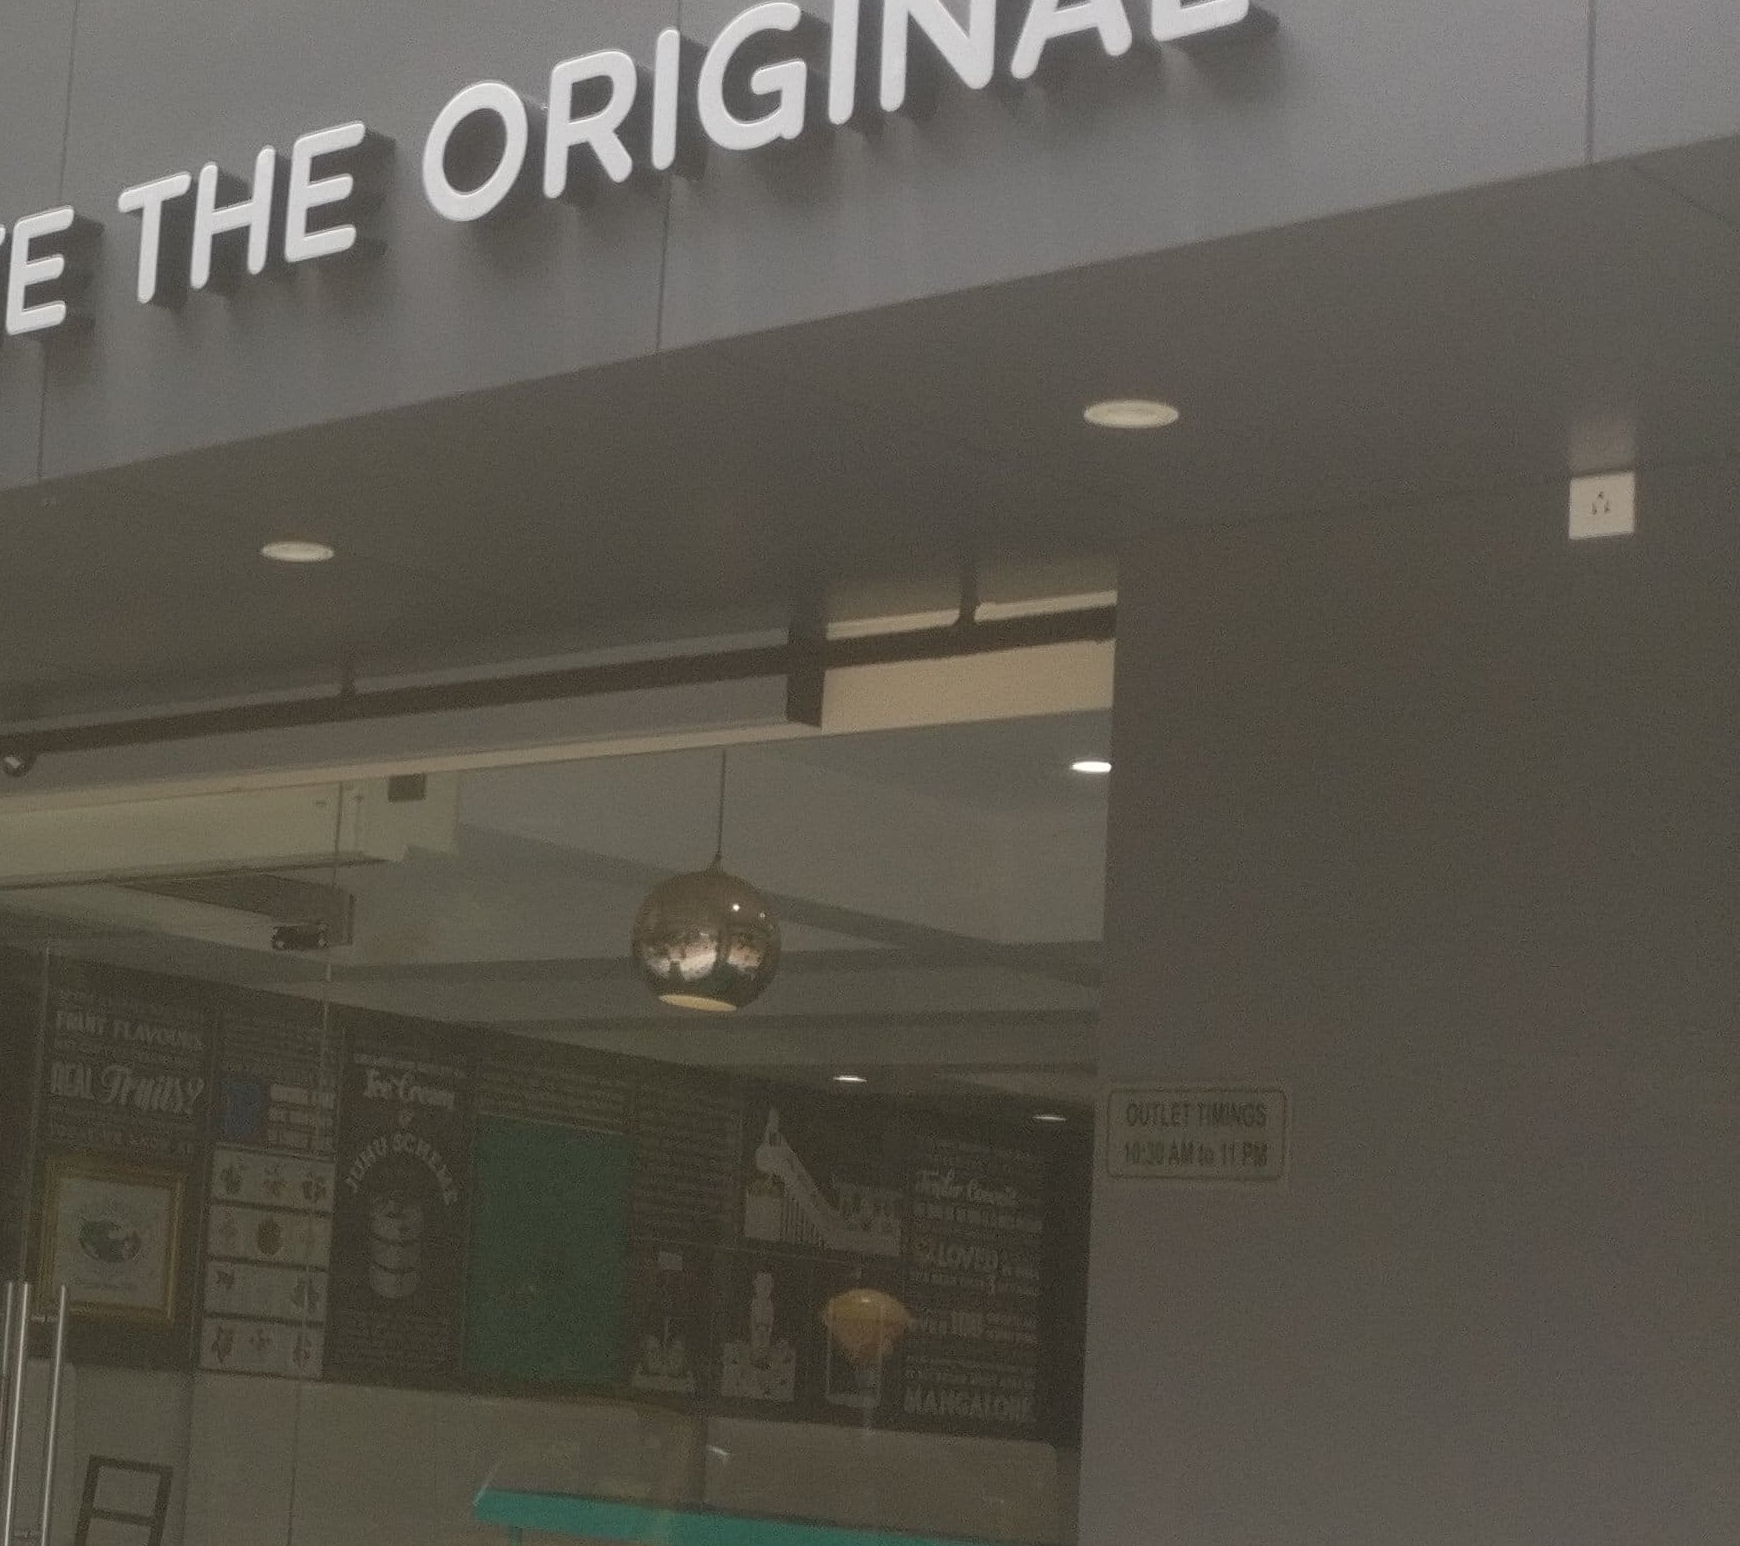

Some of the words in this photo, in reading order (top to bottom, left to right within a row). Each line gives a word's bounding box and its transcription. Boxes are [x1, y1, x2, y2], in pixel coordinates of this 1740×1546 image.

[117, 120, 366, 304] THE
[1125, 1103, 1191, 1128] OUTLET
[1197, 1102, 1267, 1128] TIMINGS
[1168, 1139, 1195, 1166] AM
